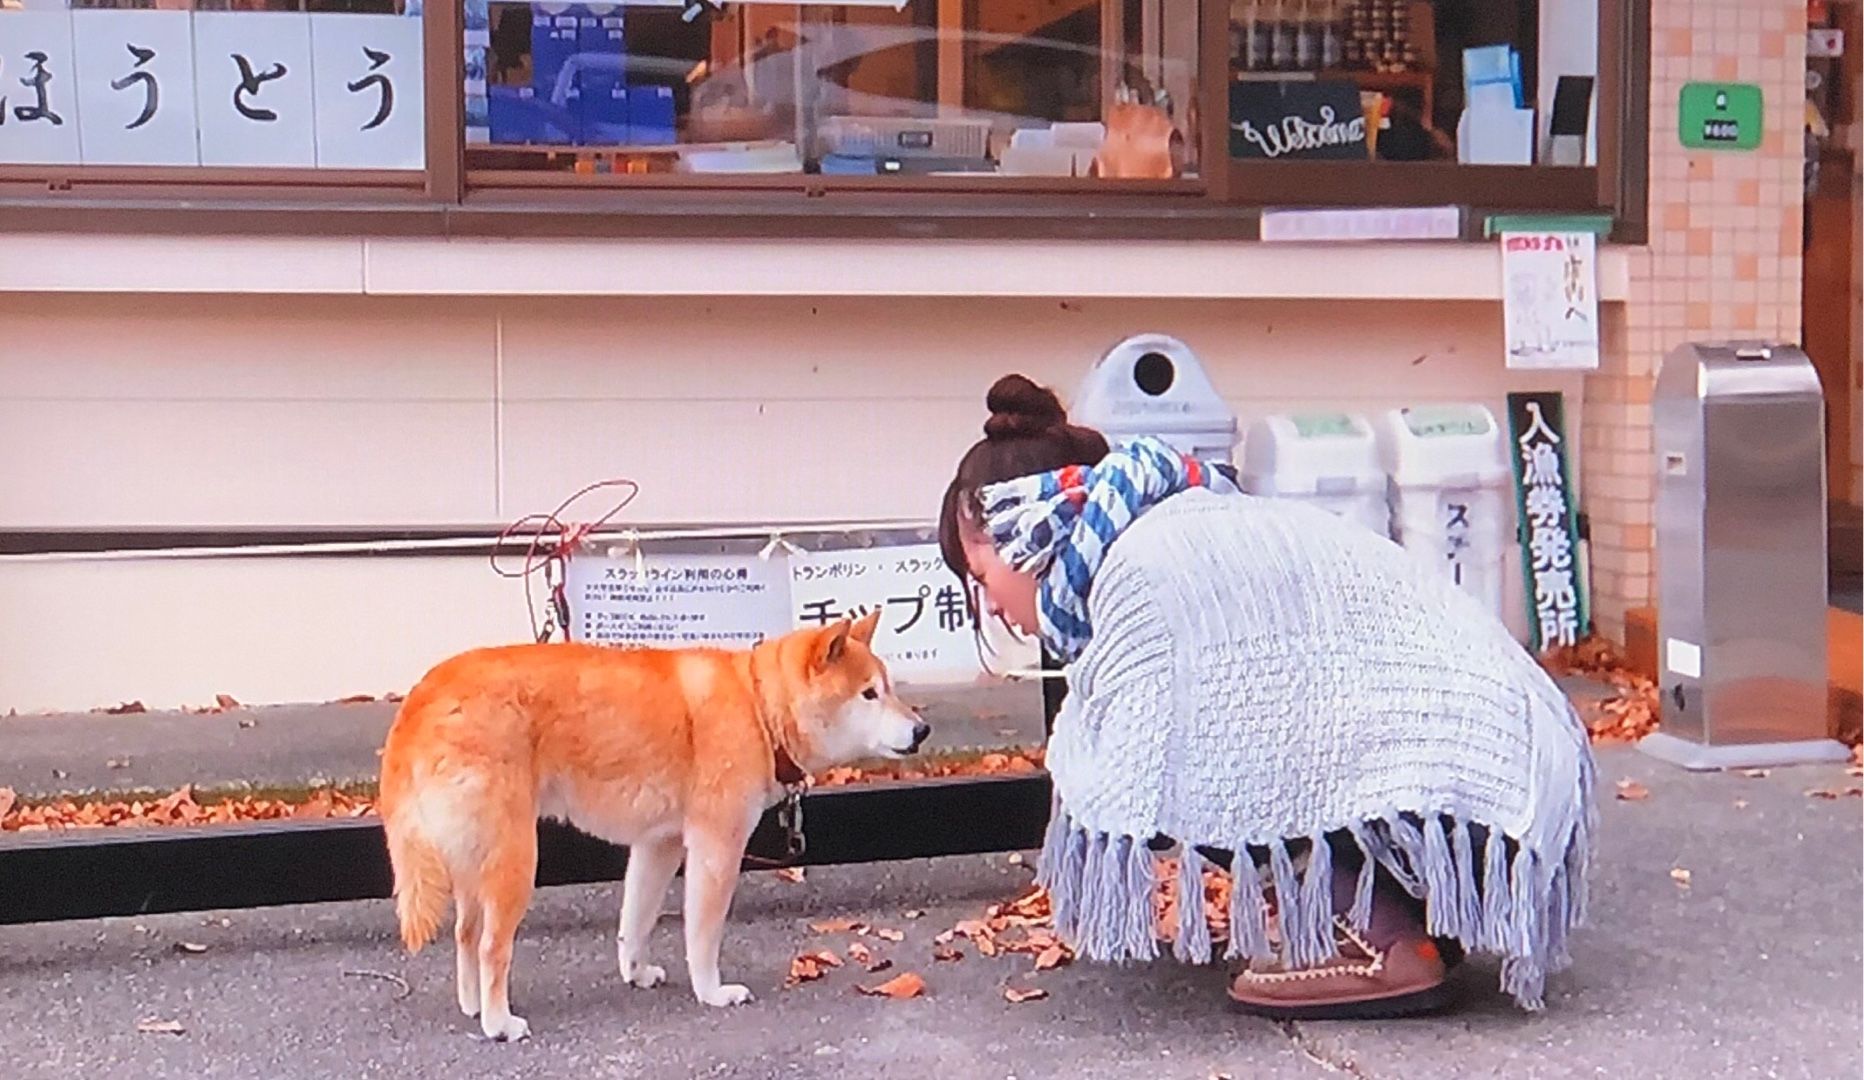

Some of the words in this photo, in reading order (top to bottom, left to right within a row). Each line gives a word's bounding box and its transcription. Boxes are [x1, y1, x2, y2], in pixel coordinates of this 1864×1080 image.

[1231, 105, 1366, 157] Welcome
[1518, 402, 1579, 652] 入漁券発売所
[793, 563, 867, 581] トランポリン
